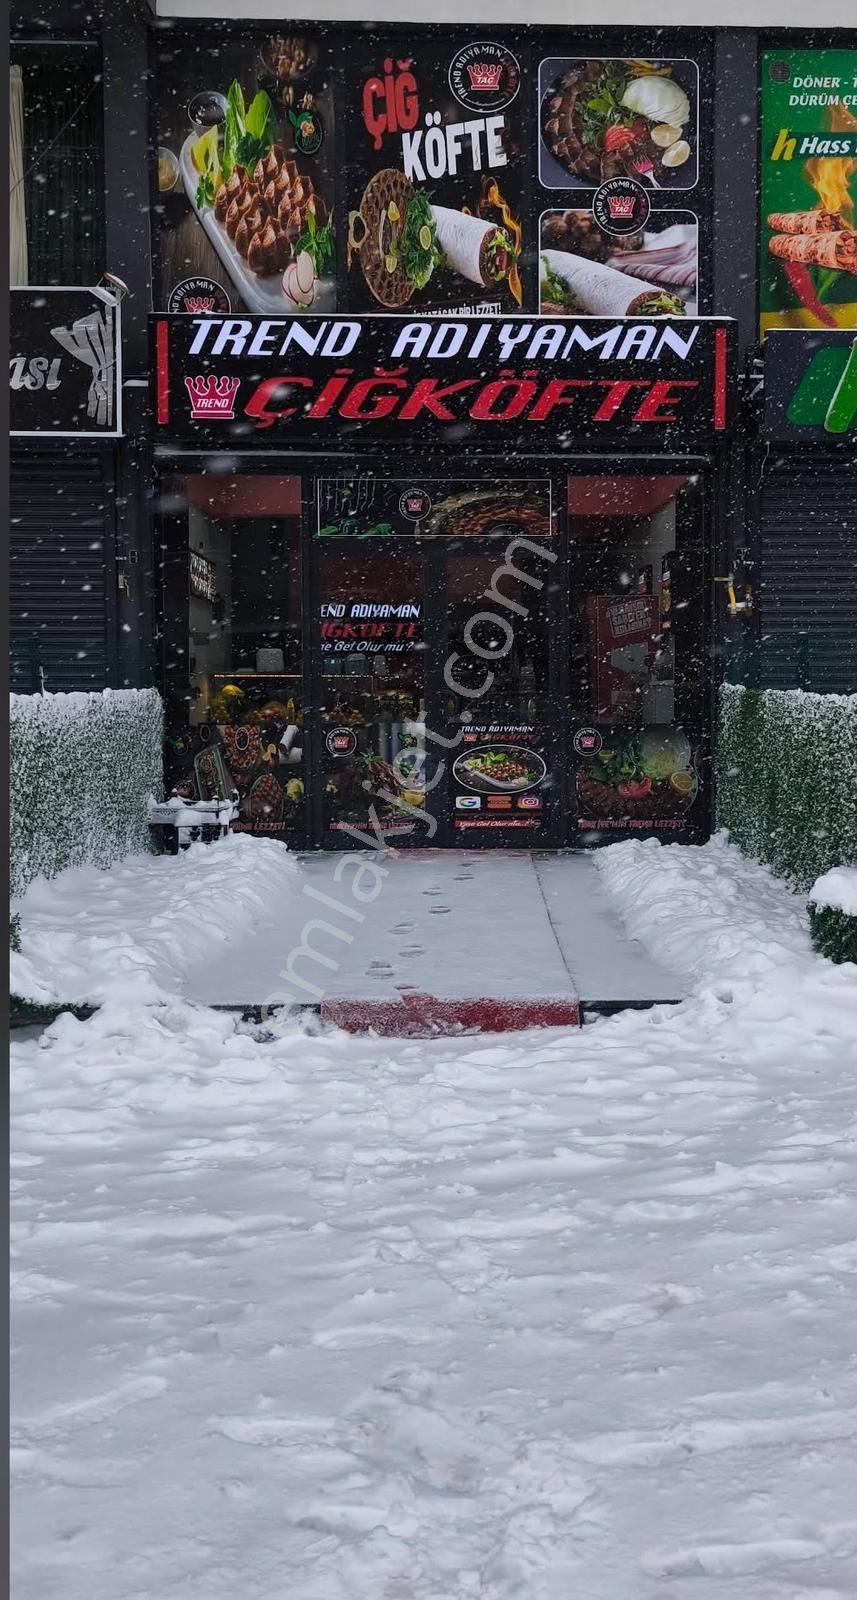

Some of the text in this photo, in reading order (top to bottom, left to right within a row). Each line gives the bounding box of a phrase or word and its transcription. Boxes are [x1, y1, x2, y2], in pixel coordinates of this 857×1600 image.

[793, 75, 840, 88] DÖNER
[363, 57, 420, 150] ÇİĞ
[789, 93, 839, 106] DÜRÜM
[401, 111, 507, 183] KÖFTE
[799, 136, 851, 154] Hass
[188, 319, 700, 361] TREND ADIYAMAN
[196, 399, 230, 408] TREND
[243, 366, 700, 429] ÇİĞKÖFTE
[320, 603, 421, 618] END ADIYAMAN
